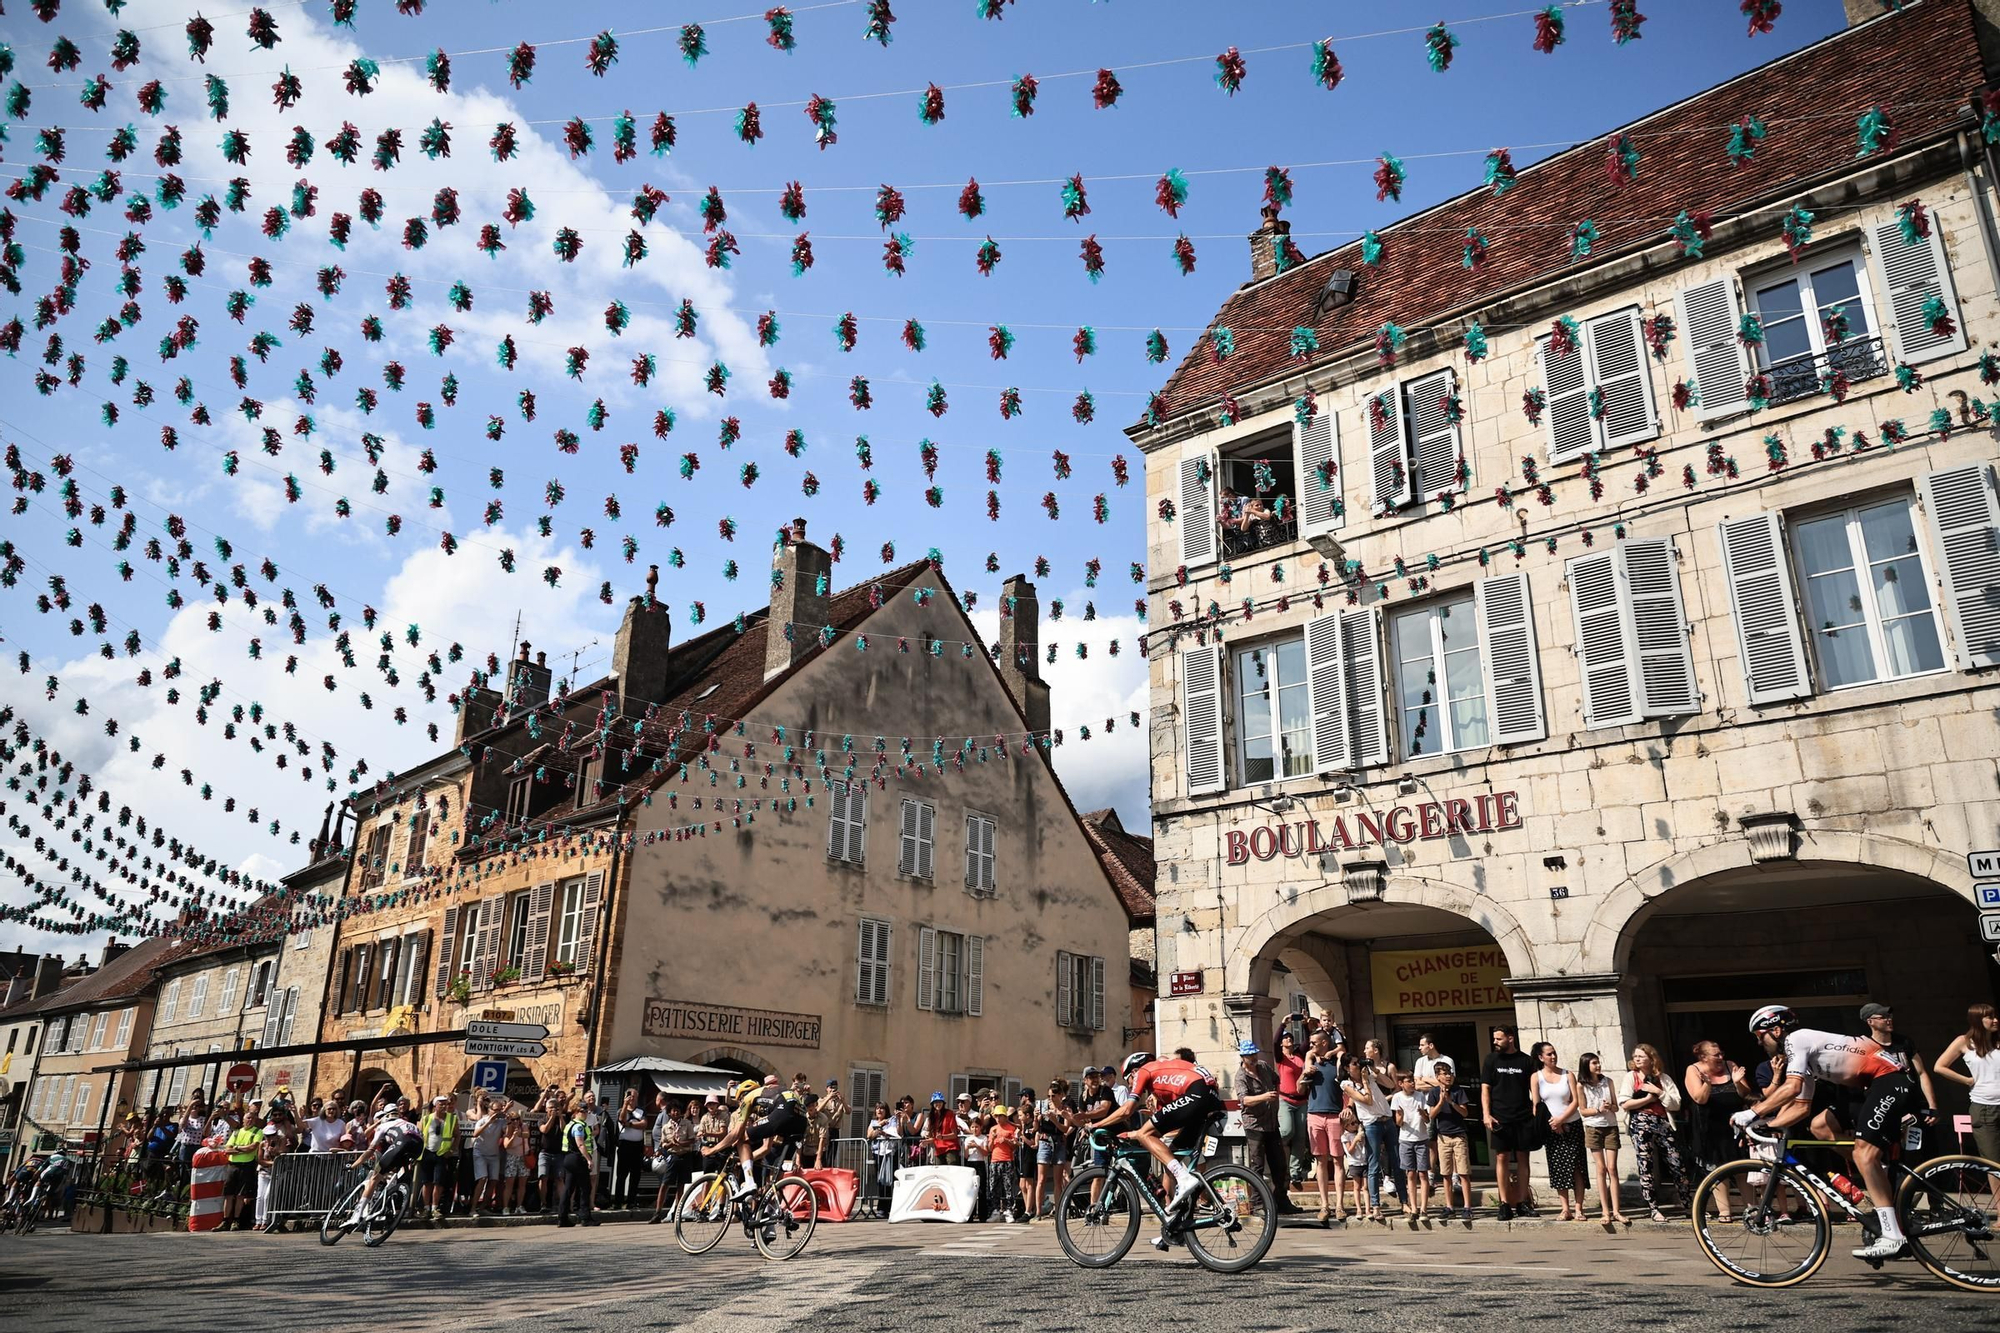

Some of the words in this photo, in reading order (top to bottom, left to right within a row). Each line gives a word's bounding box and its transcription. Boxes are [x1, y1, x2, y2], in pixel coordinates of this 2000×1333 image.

[1225, 790, 1523, 866] BOULANGERIE
[1977, 858, 2000, 870] M
[1552, 888, 1566, 898] 36
[1396, 951, 1509, 982] CHANGEME
[1461, 972, 1478, 984] DE
[1400, 986, 1514, 1009] PROPRIETA
[471, 1024, 498, 1034] DOLE
[650, 1006, 743, 1034] PATISSERIE
[747, 1016, 820, 1042] HIRSINGER
[468, 1042, 515, 1053] MONTIGNY
[1824, 1042, 1866, 1056] Cofidis
[1153, 1074, 1187, 1087] ARKEA
[1162, 1096, 1195, 1115] ARKEA
[1867, 1094, 1896, 1131] Cofidis
[1908, 1130, 1921, 1146] 124
[1795, 1165, 1863, 1217] LOOK
